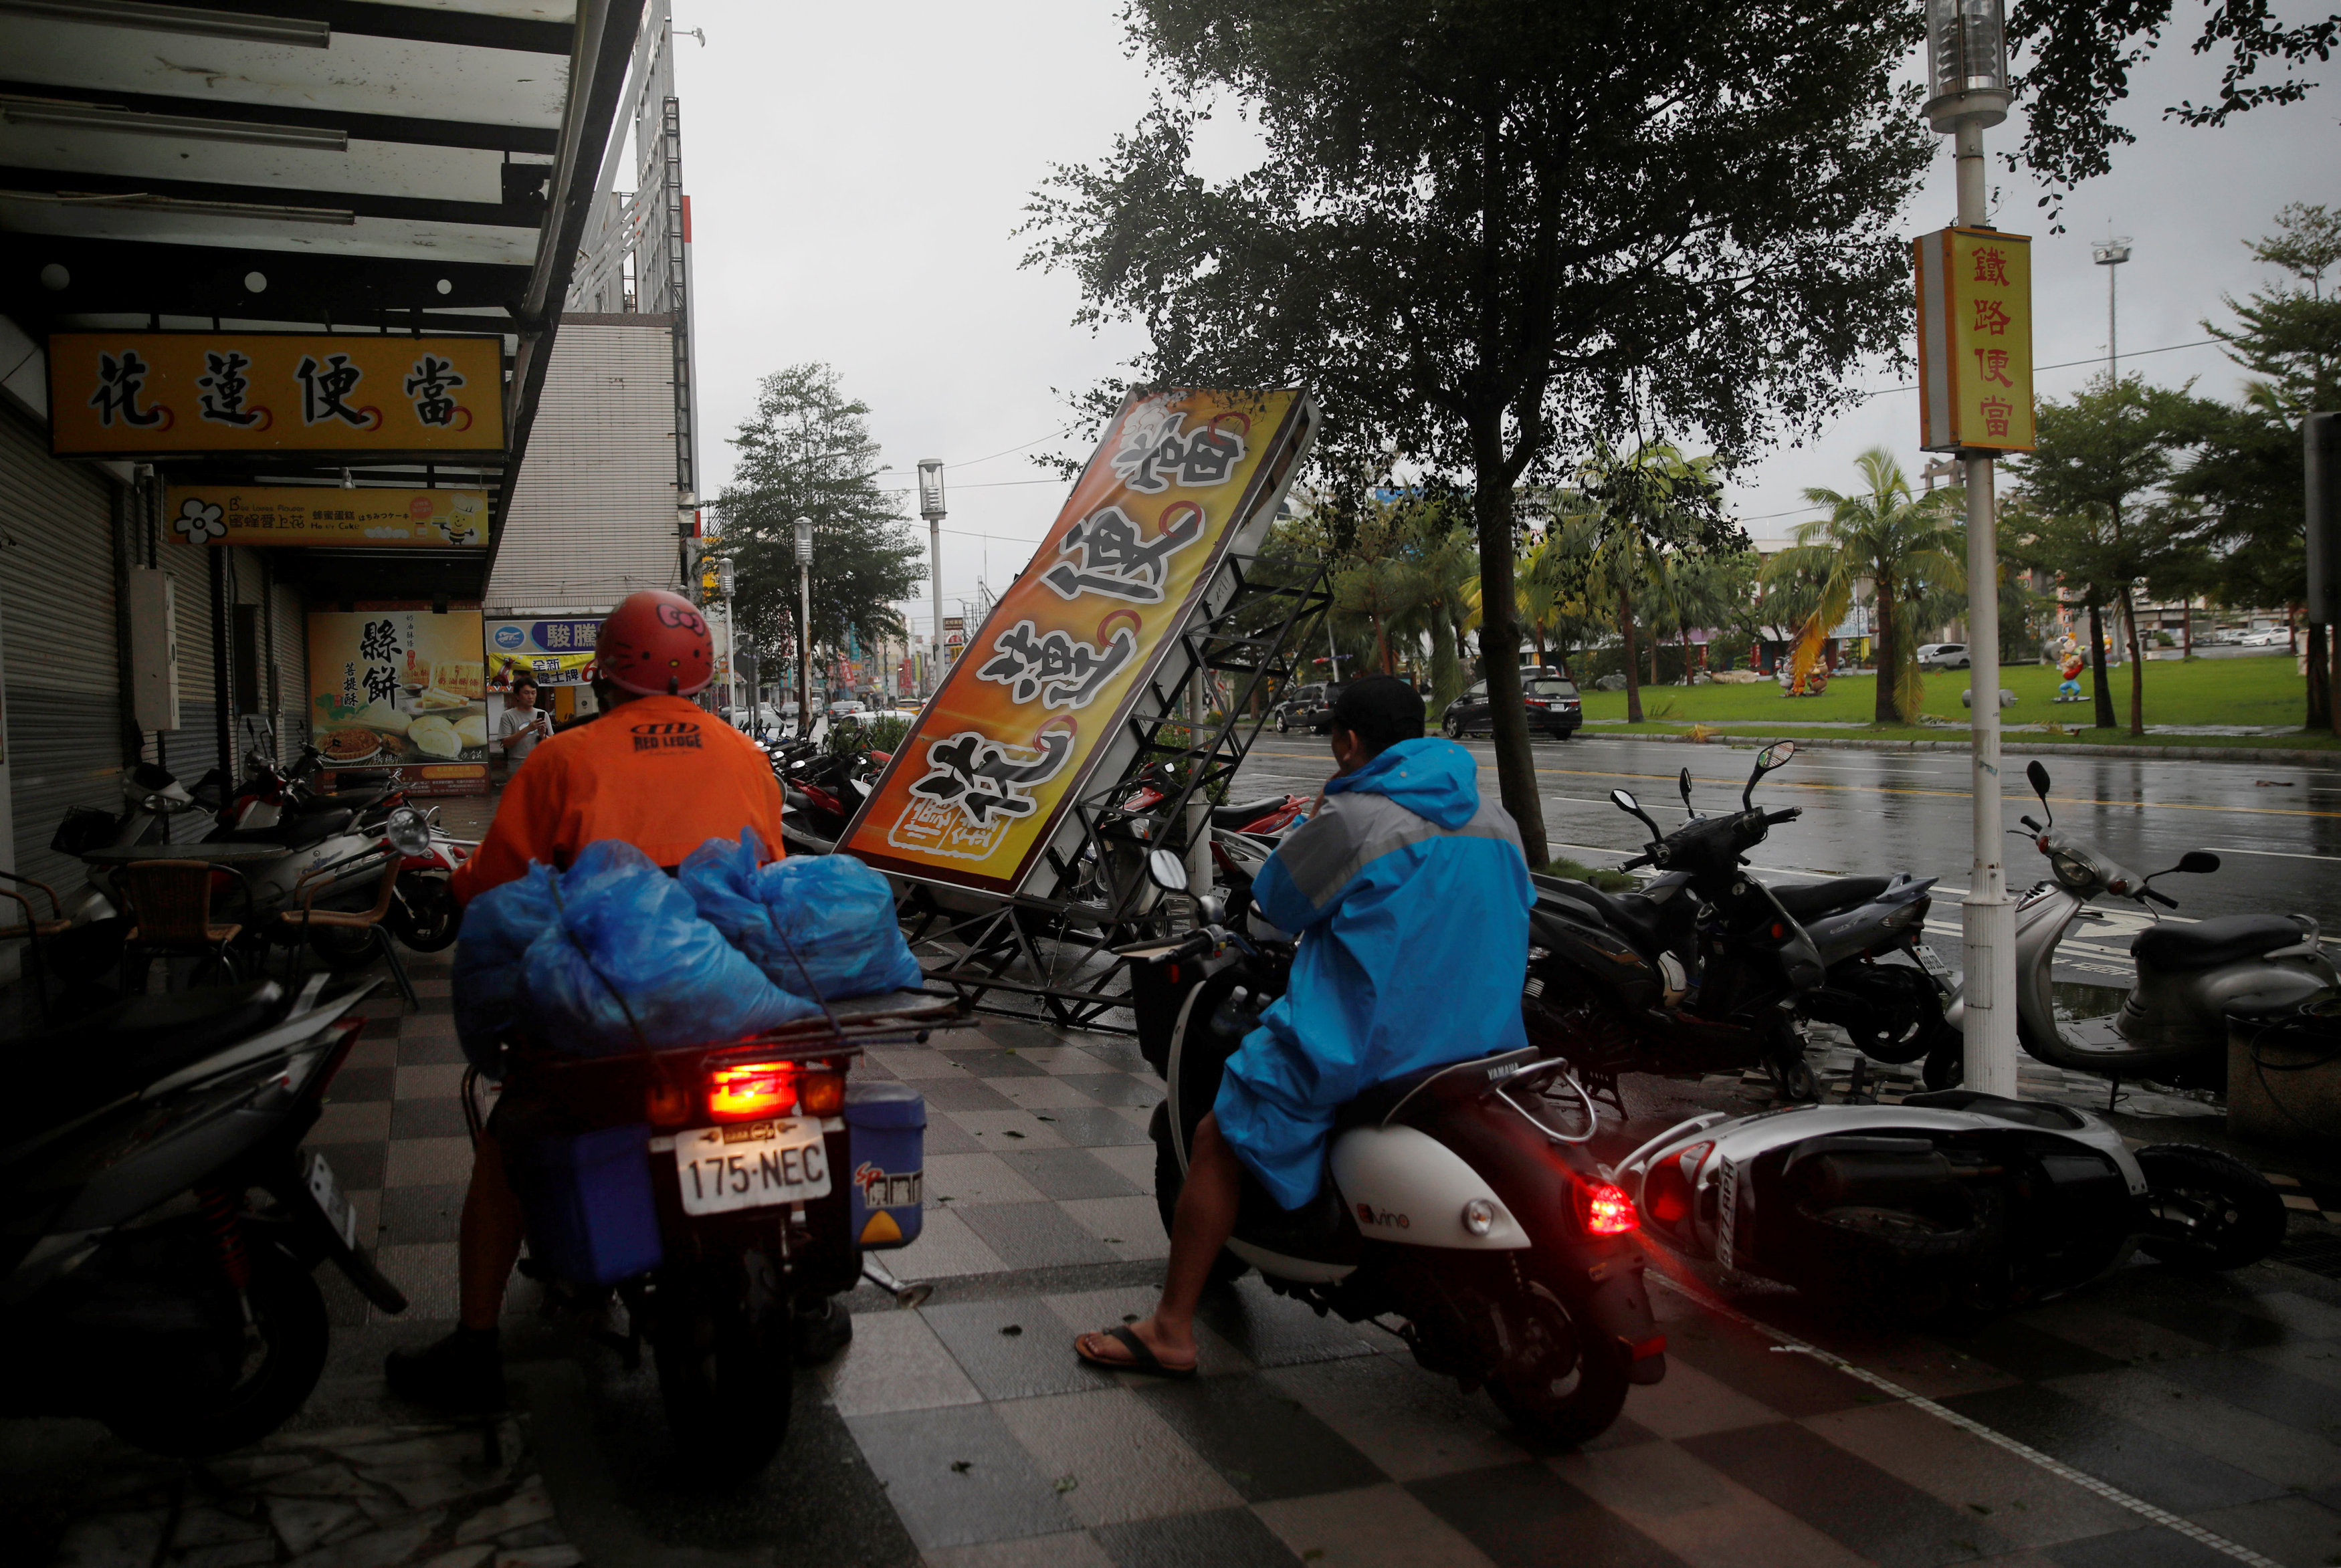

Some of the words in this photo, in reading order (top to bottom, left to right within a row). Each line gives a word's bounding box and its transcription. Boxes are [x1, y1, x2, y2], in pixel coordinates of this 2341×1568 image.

[1972, 245, 2013, 438] 鐵路便當
[91, 350, 467, 429] 花蓮便當
[229, 514, 305, 529] 蜜蜂愛上花
[312, 510, 355, 521] 蜂蜜蛋糕
[359, 512, 409, 522] はちみつケーキ
[910, 410, 1245, 828] 花蓮便當
[547, 623, 597, 648] 駿騰
[360, 620, 402, 710] 縣餅
[532, 658, 561, 672] 全新
[343, 662, 359, 707] 菩提酥
[537, 669, 579, 684] 偉士牌
[633, 736, 659, 750] RED
[663, 734, 703, 749] LEDGE
[1488, 1062, 1520, 1081] YAMAHA
